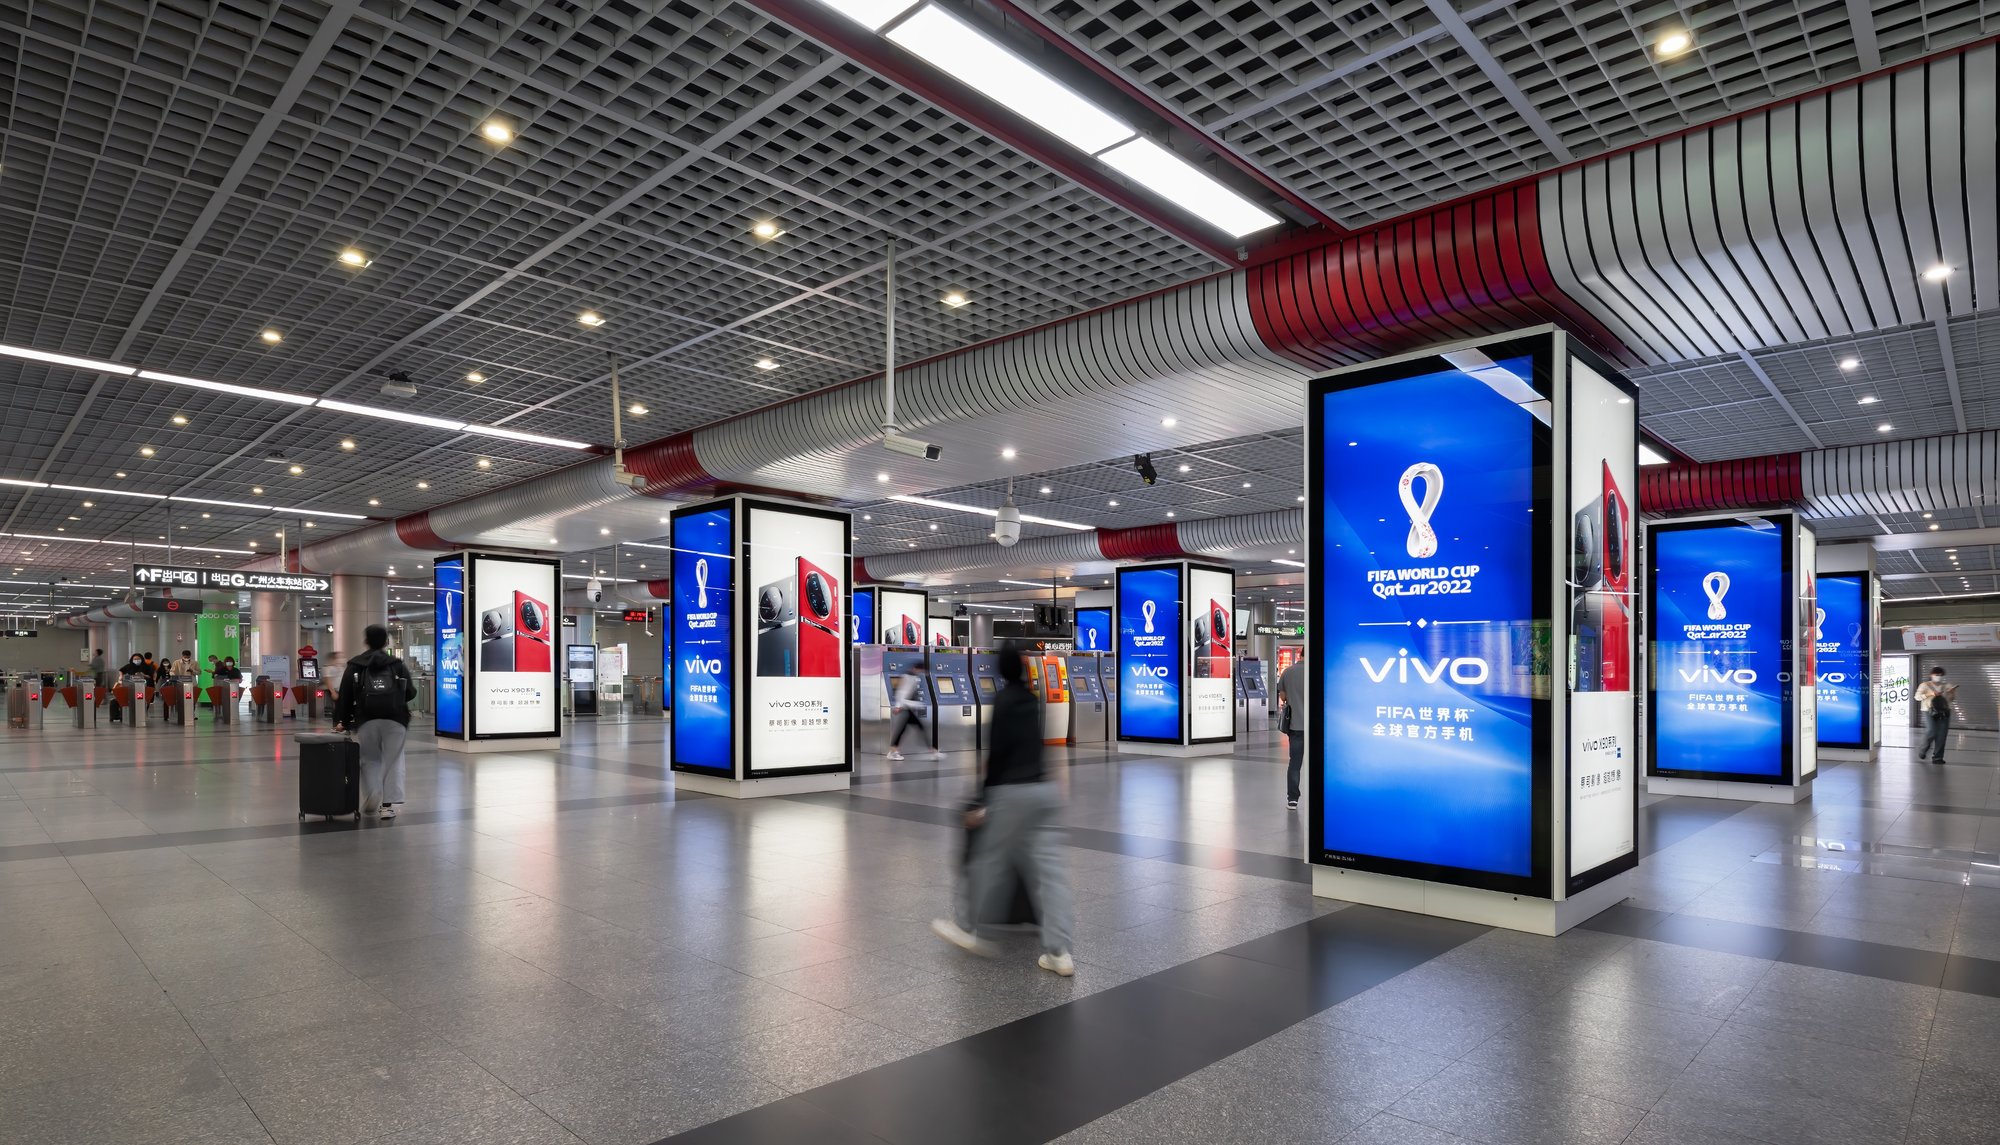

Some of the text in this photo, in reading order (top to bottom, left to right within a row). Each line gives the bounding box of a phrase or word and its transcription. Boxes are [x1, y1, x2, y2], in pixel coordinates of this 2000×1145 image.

[150, 569, 182, 582] F 出口
[211, 573, 245, 587] 出口 G
[249, 575, 302, 586] 广州火车东站
[1367, 565, 1480, 582] FIFA WORLD CUP
[224, 625, 237, 638] 保
[441, 657, 459, 670] vivo
[685, 654, 722, 674] vivo
[1131, 663, 1169, 677] vivo
[1359, 648, 1489, 685] vivo
[1678, 664, 1757, 684] vivo
[1372, 722, 1474, 741] 全球官方手机
[1582, 738, 1599, 752] vivo
